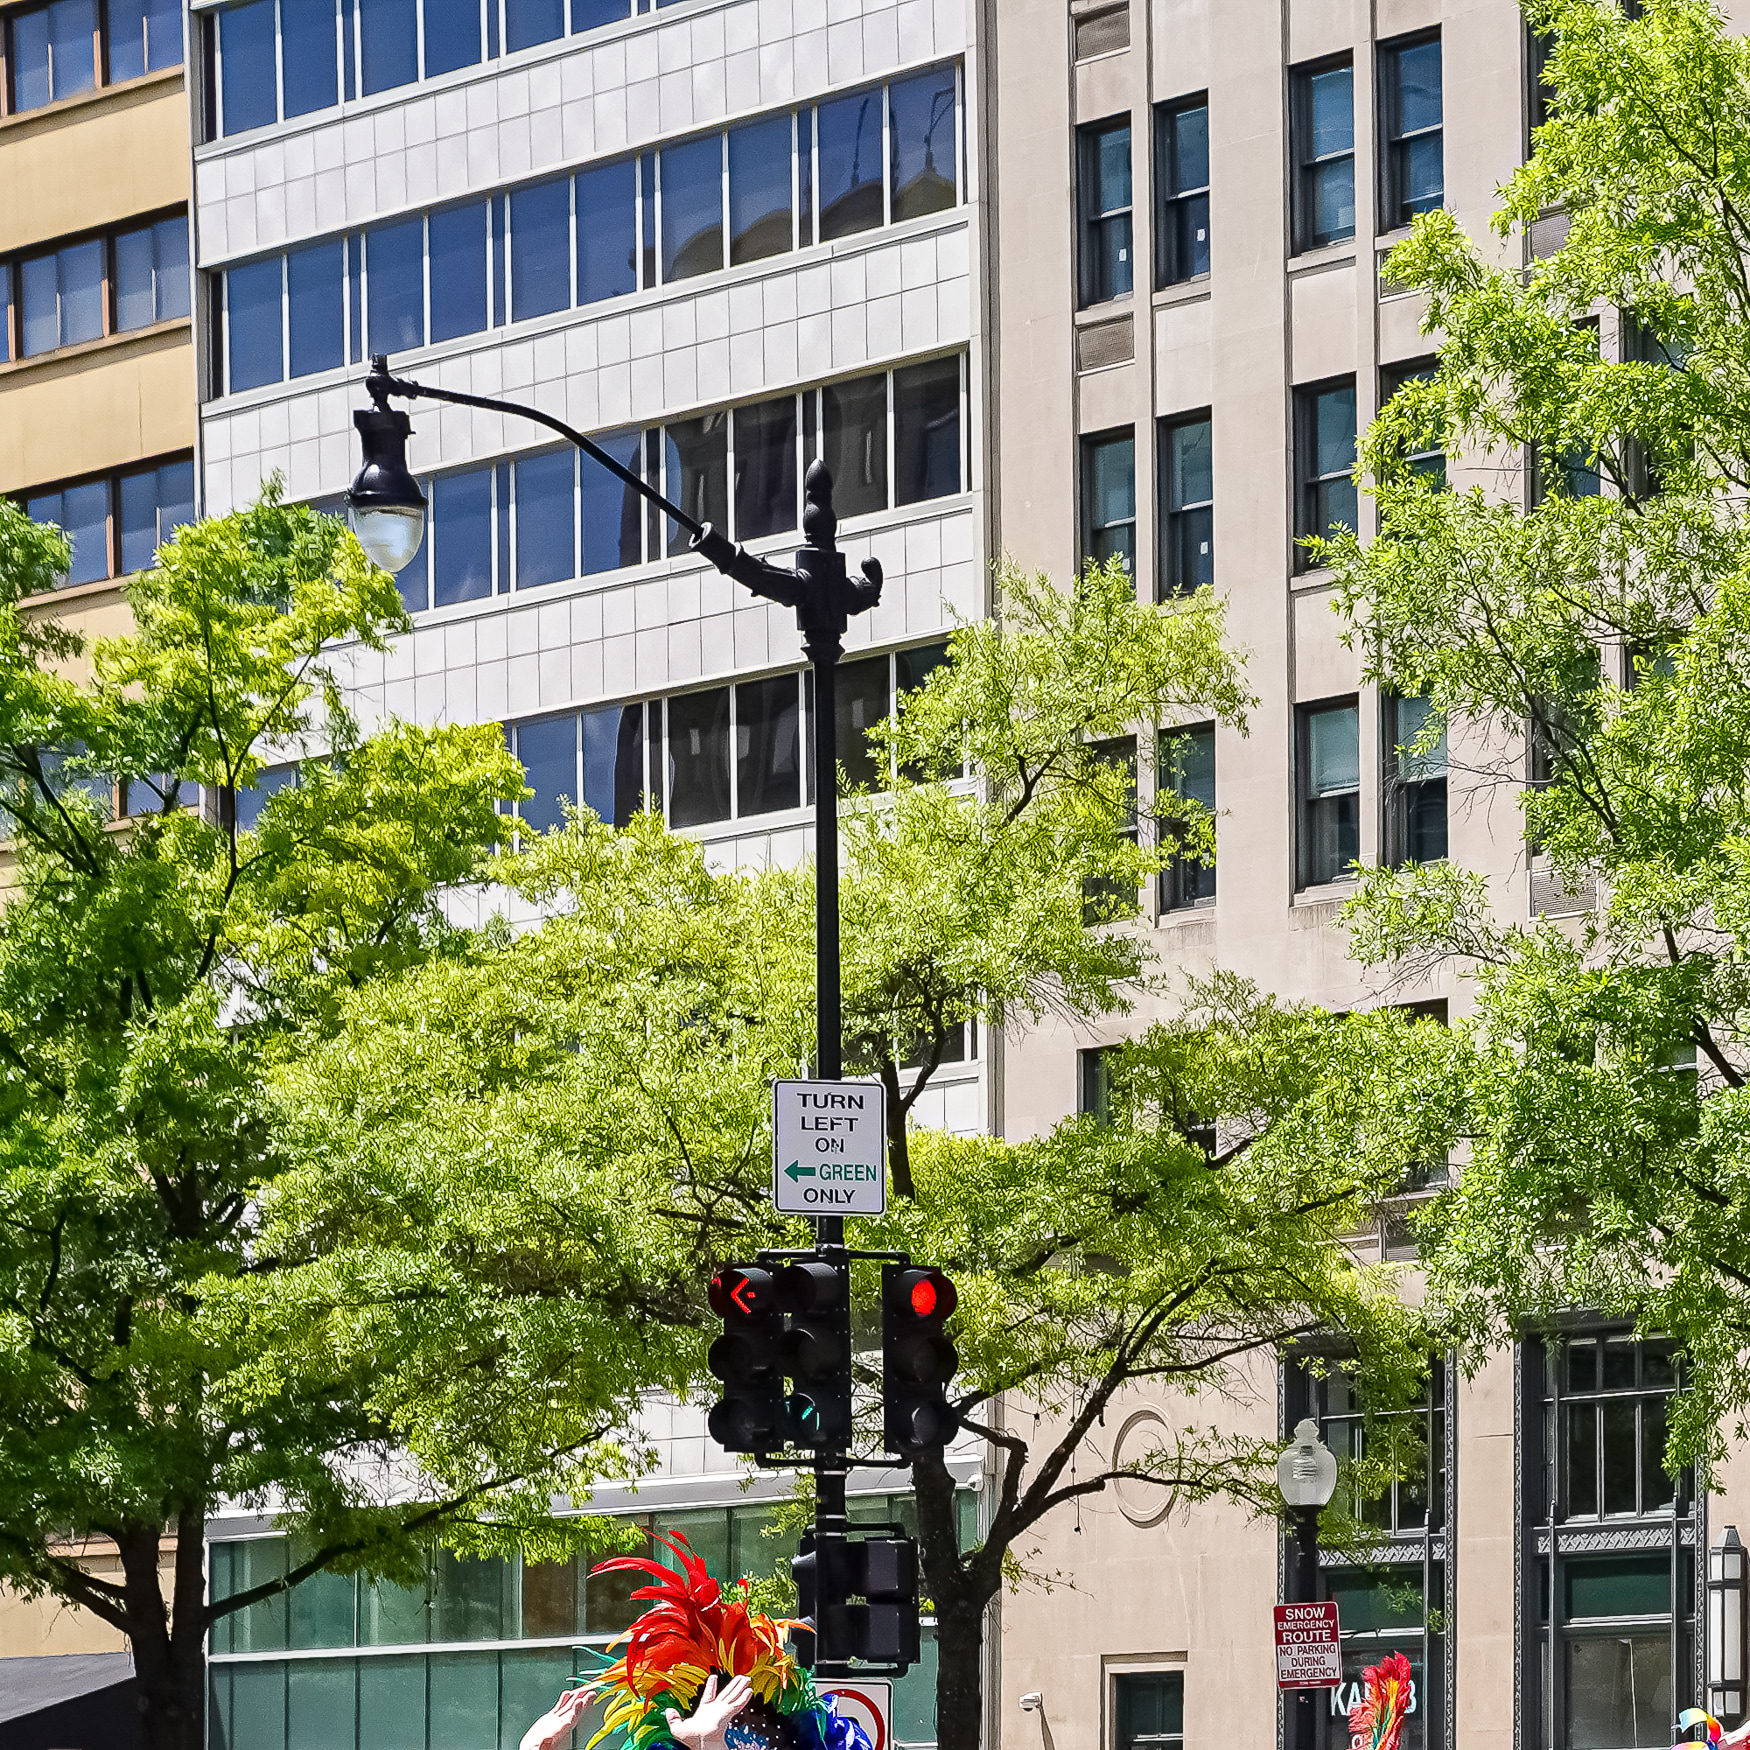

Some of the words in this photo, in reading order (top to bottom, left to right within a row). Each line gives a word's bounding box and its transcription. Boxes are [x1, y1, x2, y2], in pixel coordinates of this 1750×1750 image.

[797, 1092, 864, 1110] TURN
[801, 1116, 858, 1132] LEFT
[815, 1137, 844, 1153] ON
[819, 1163, 877, 1181] GREEN
[803, 1188, 856, 1204] ONLY
[1285, 1606, 1326, 1620] SNOW
[1277, 1619, 1335, 1630] EMERGENCY
[1282, 1629, 1332, 1643] ROUTE
[1280, 1646, 1293, 1657] NO
[1297, 1643, 1336, 1656] PARKING
[1291, 1655, 1326, 1668] DURING
[1280, 1667, 1337, 1679] EMERGENCY
